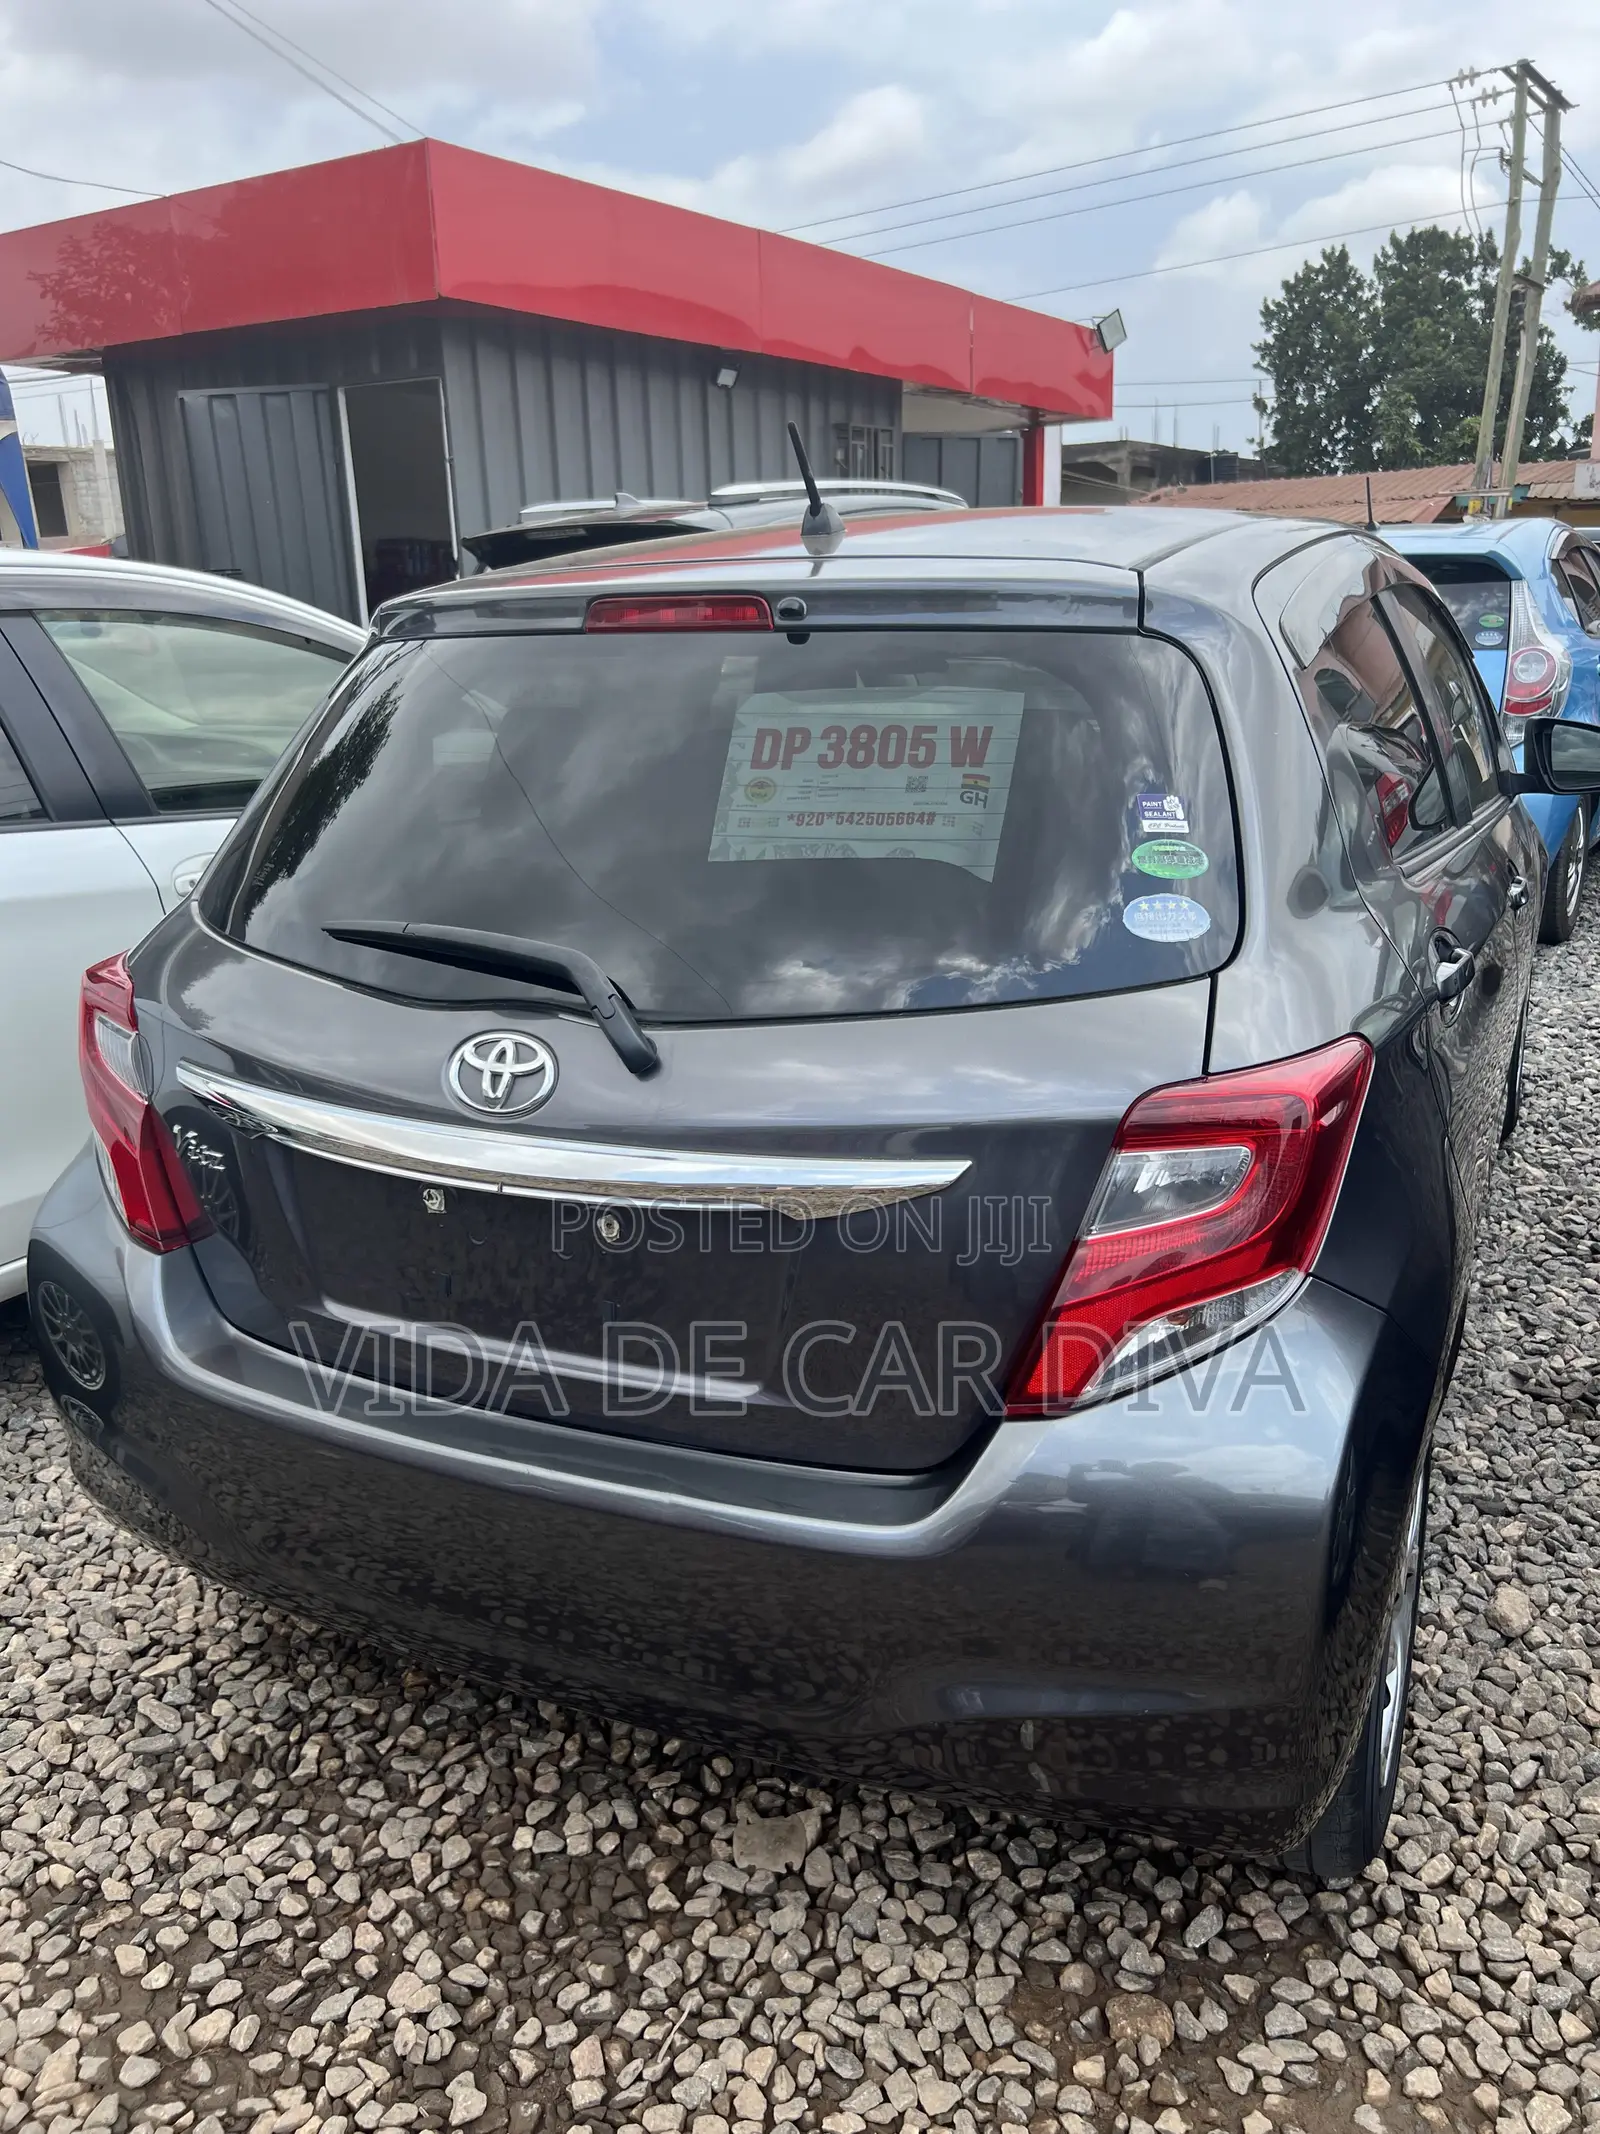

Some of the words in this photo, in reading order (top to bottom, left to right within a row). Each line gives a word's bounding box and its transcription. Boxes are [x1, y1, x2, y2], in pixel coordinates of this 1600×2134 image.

[750, 726, 811, 770] DP
[817, 724, 937, 769] 3805
[949, 725, 993, 768] W
[959, 790, 988, 809] GH
